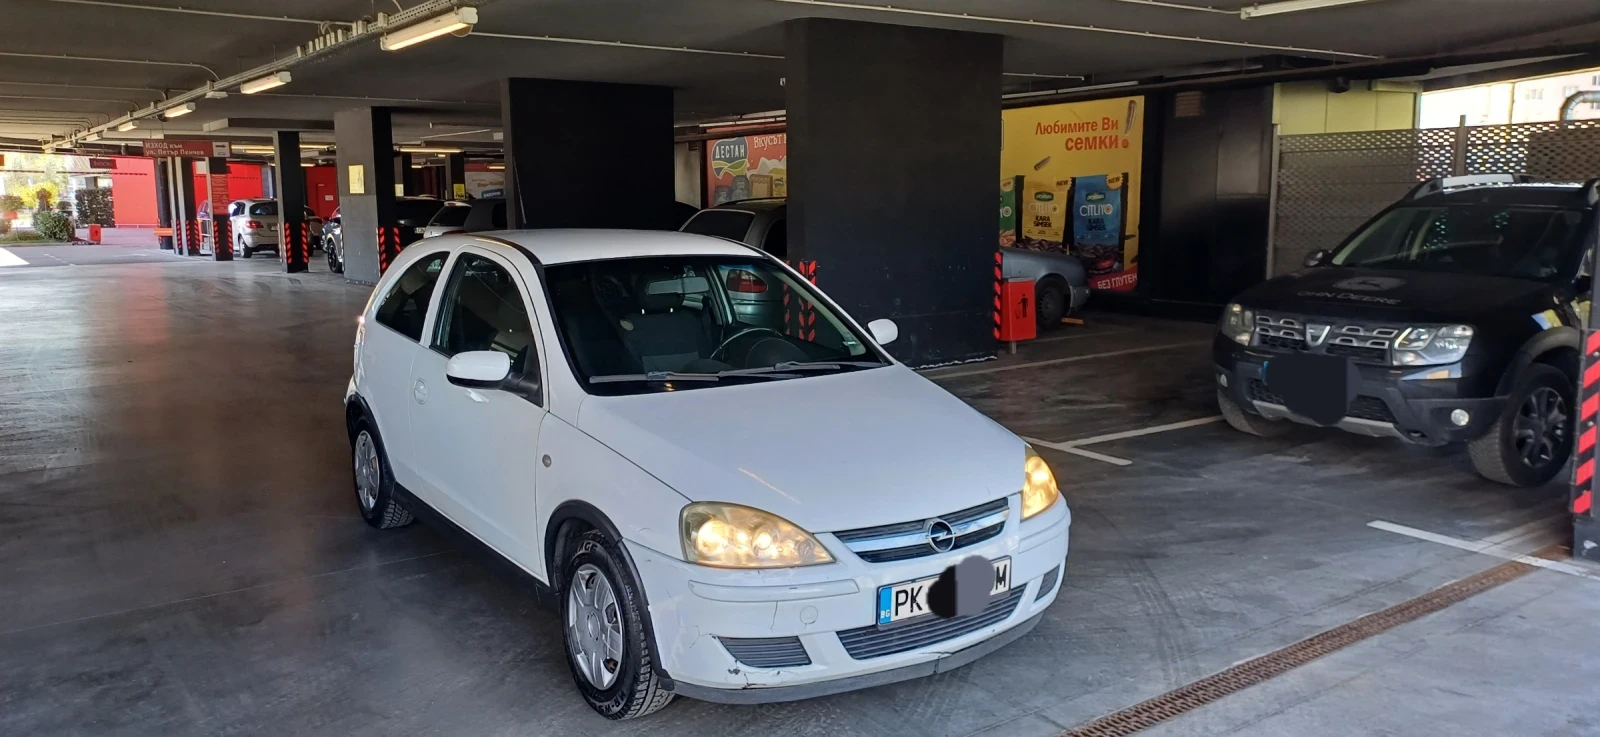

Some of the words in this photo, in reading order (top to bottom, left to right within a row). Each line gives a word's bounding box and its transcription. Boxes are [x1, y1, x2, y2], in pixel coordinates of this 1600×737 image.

[1035, 119, 1098, 136] Любимите
[1101, 117, 1119, 131] Ви
[145, 142, 168, 150] ИЗХОД
[753, 134, 782, 151] Вкусът
[158, 149, 179, 157] Петър
[715, 144, 745, 159] ДЕСТАН
[1056, 179, 1069, 187] NEW
[1108, 176, 1121, 184] NEW
[1097, 278, 1111, 290] БЕЗ
[1111, 272, 1138, 288] ГЛУТЕН
[894, 585, 923, 616] PK
[995, 564, 1008, 591] M
[880, 609, 891, 619] BG
